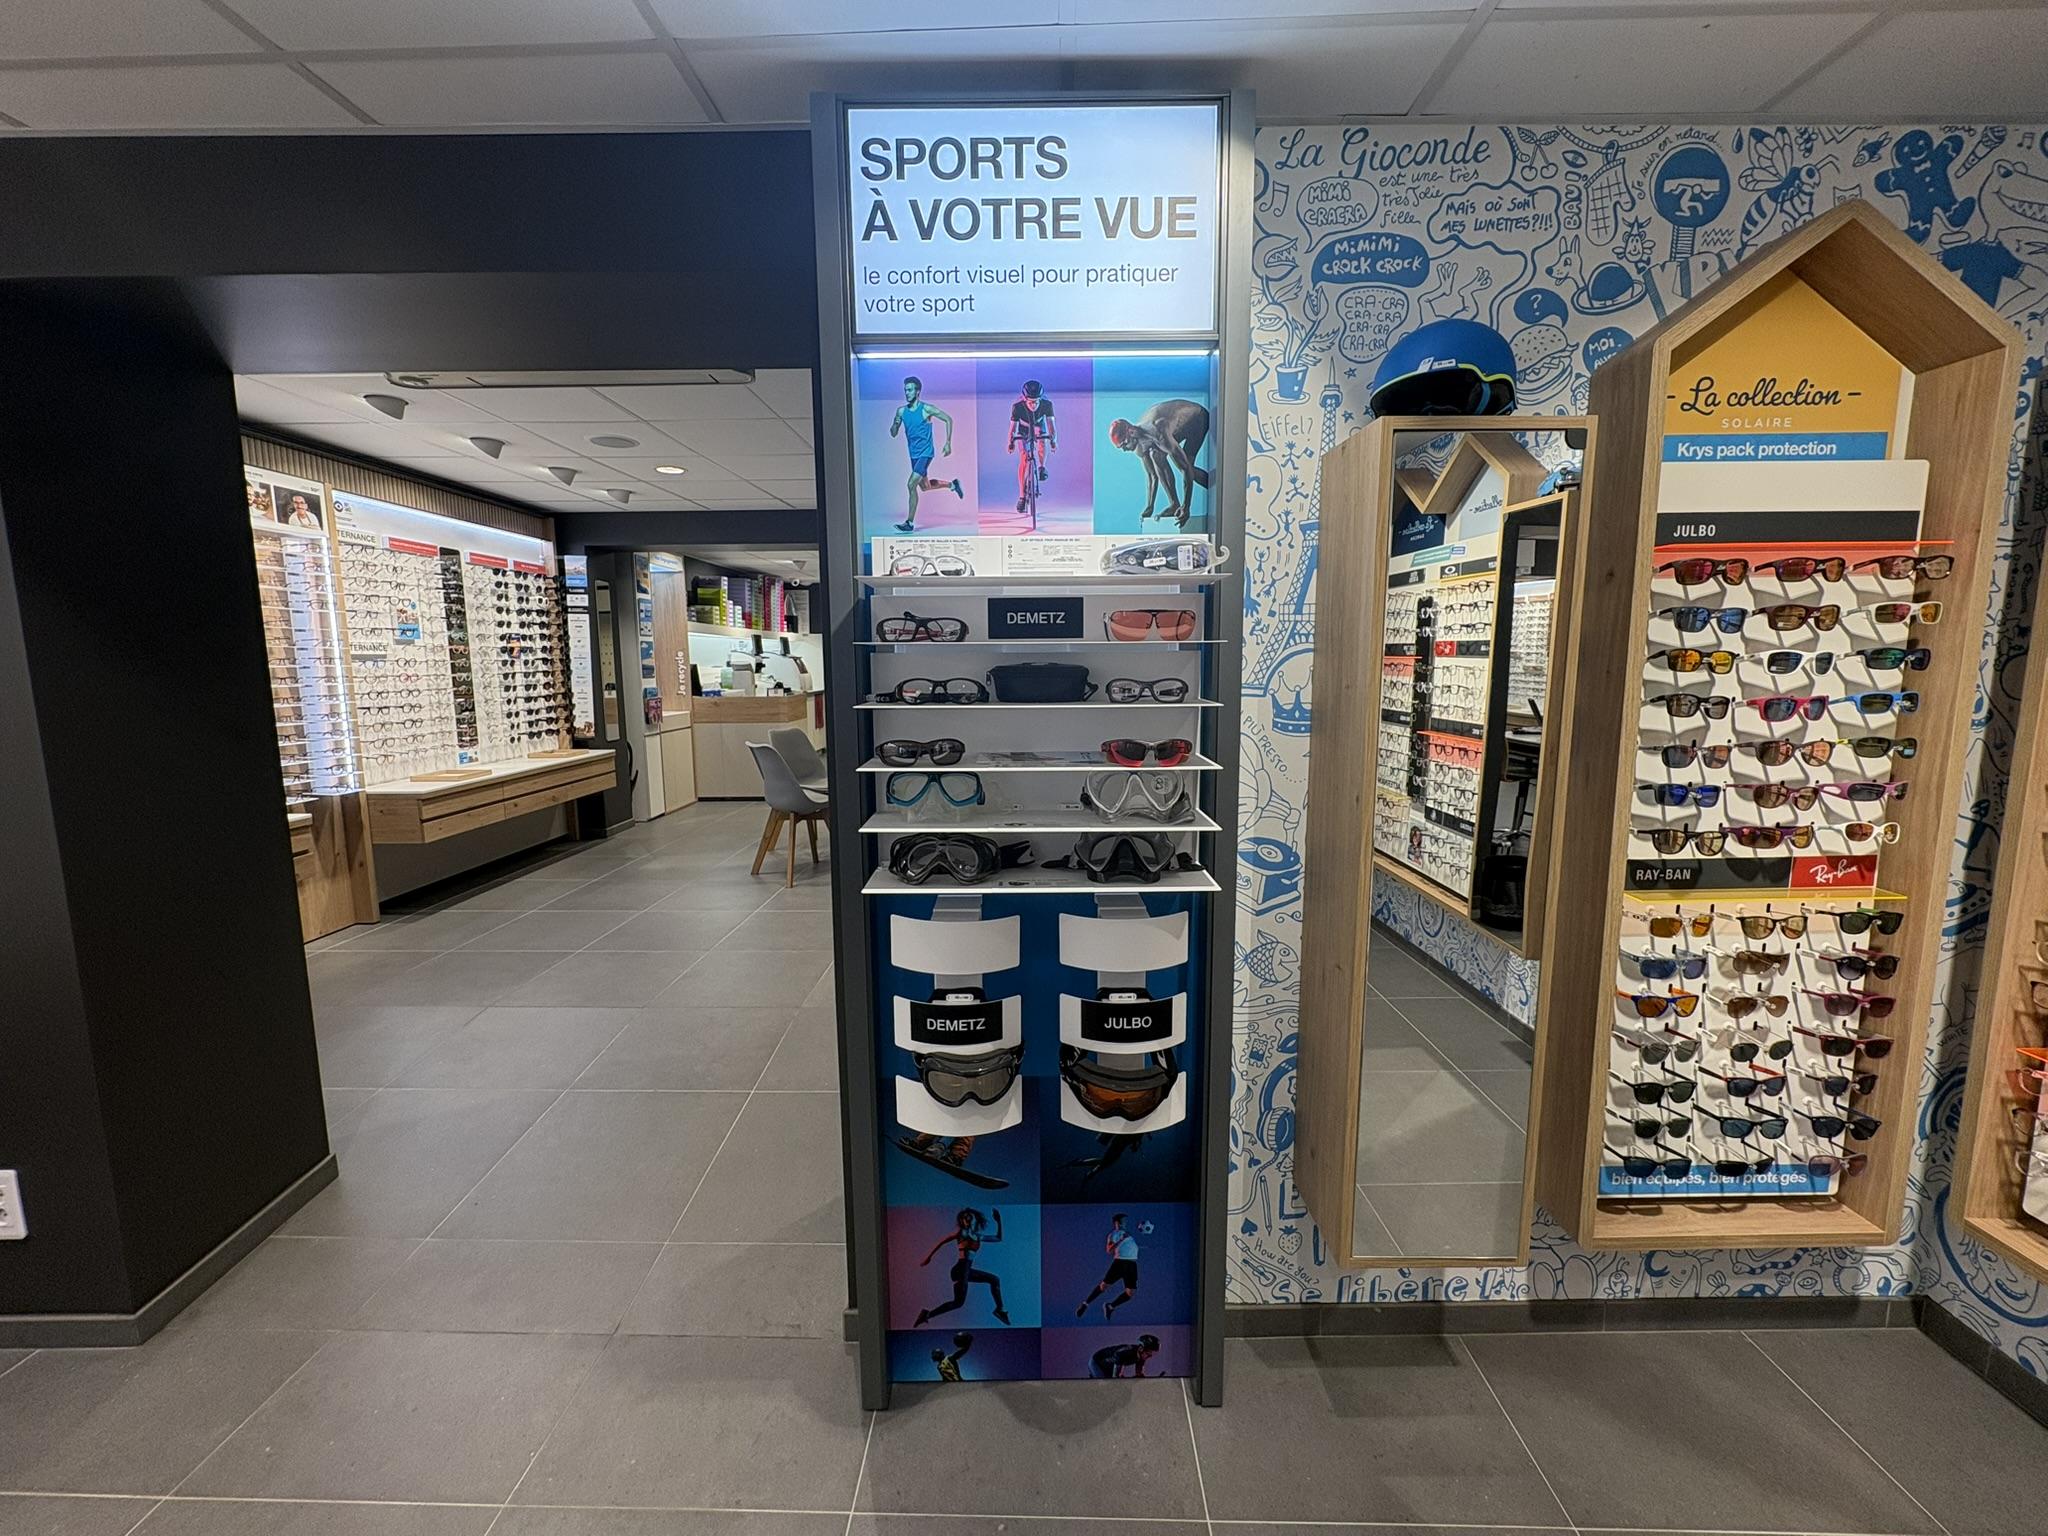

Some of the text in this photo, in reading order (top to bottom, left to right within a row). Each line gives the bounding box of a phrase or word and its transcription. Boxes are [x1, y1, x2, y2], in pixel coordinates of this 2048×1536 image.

[860, 136, 1068, 181] SPORTS
[1274, 126, 1491, 178] La Gioconde
[1379, 165, 1479, 187] est une très
[1382, 192, 1409, 207] très
[861, 188, 1197, 241] À VOTRE VUE
[1304, 203, 1367, 226] CRACRA
[1440, 220, 1466, 233] MES
[1376, 255, 1423, 275] CROCK
[863, 264, 1179, 289] le confort visuel pour pratiquer
[863, 294, 975, 317] votre sport
[1680, 376, 1842, 416] La collection
[1721, 417, 1793, 429] SOLAIRE
[1677, 441, 1836, 460] Krys pack protection
[1673, 524, 1717, 538] JULBO
[1007, 612, 1066, 625] DEMETZ
[1636, 867, 1691, 881] RAY-BAN
[1809, 859, 1858, 884] Ray-Ban
[926, 1018, 986, 1032] DEMETZ
[1104, 1015, 1152, 1030] JULBO
[1611, 1173, 1642, 1185] bien
[1709, 1172, 1740, 1184] bien
[1743, 1171, 1807, 1186] protégés
[1254, 1237, 1275, 1260] How
[1277, 1256, 1294, 1270] are
[1336, 1267, 1469, 1303] libère
